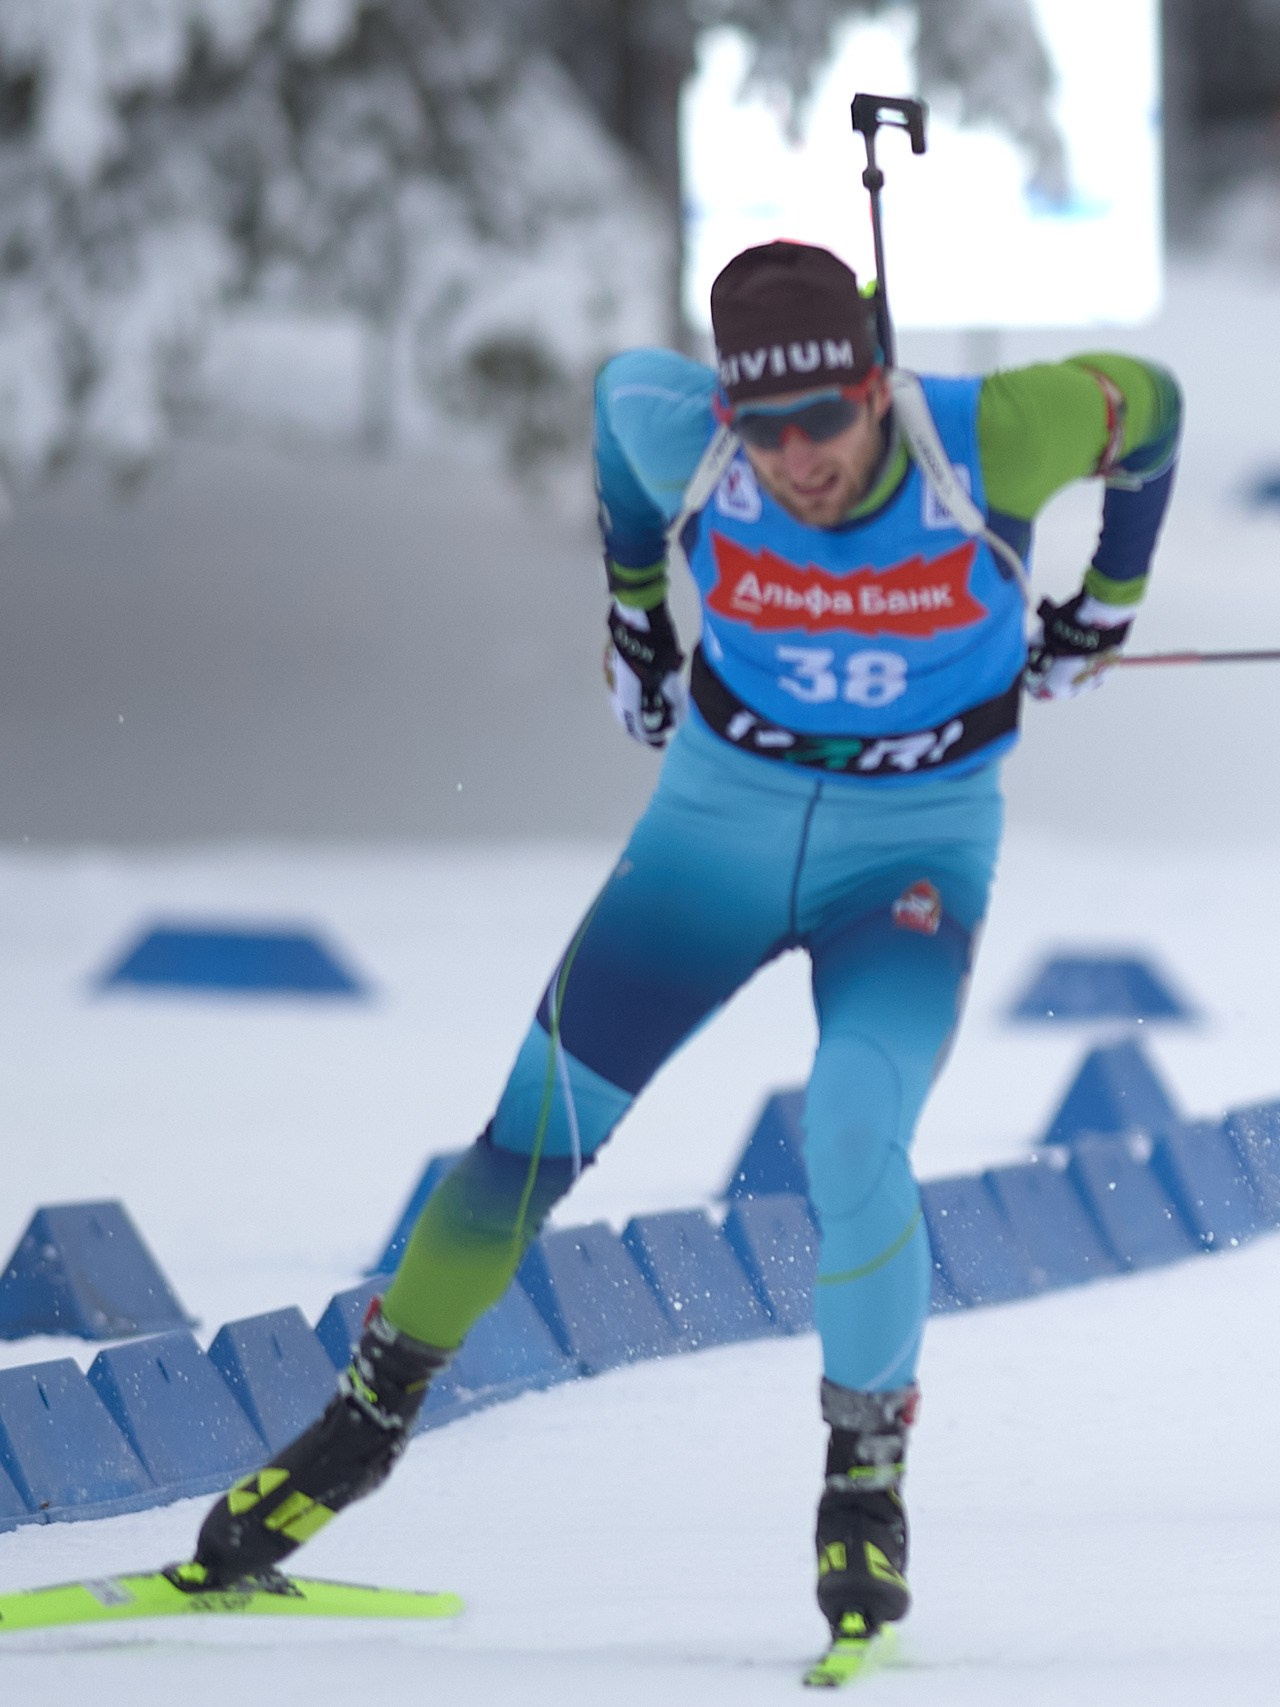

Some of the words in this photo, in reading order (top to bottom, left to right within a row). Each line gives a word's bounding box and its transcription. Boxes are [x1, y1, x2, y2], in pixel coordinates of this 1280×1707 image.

[732, 571, 854, 618] Альфа
[857, 582, 954, 616] Банк
[777, 645, 909, 708] 38
